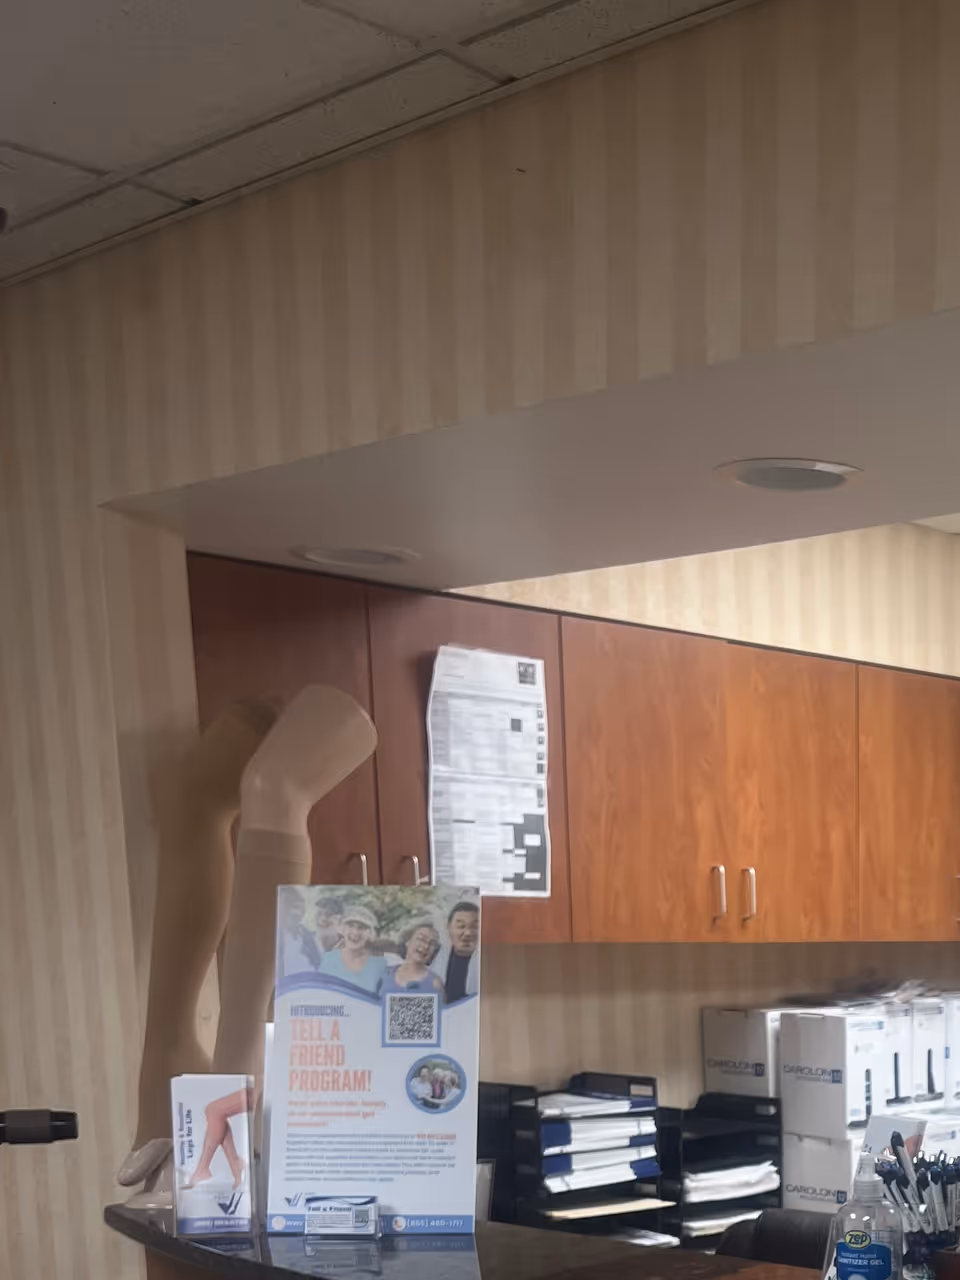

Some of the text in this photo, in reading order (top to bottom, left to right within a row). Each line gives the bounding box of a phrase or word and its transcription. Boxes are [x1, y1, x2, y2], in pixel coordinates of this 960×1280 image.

[290, 1018, 341, 1041] TELL A
[289, 1044, 346, 1067] FRIEND
[288, 1069, 372, 1093] PROGRAM!
[785, 1184, 837, 1198] CAROLON
[838, 1256, 885, 1267] SANITIZER GEL
